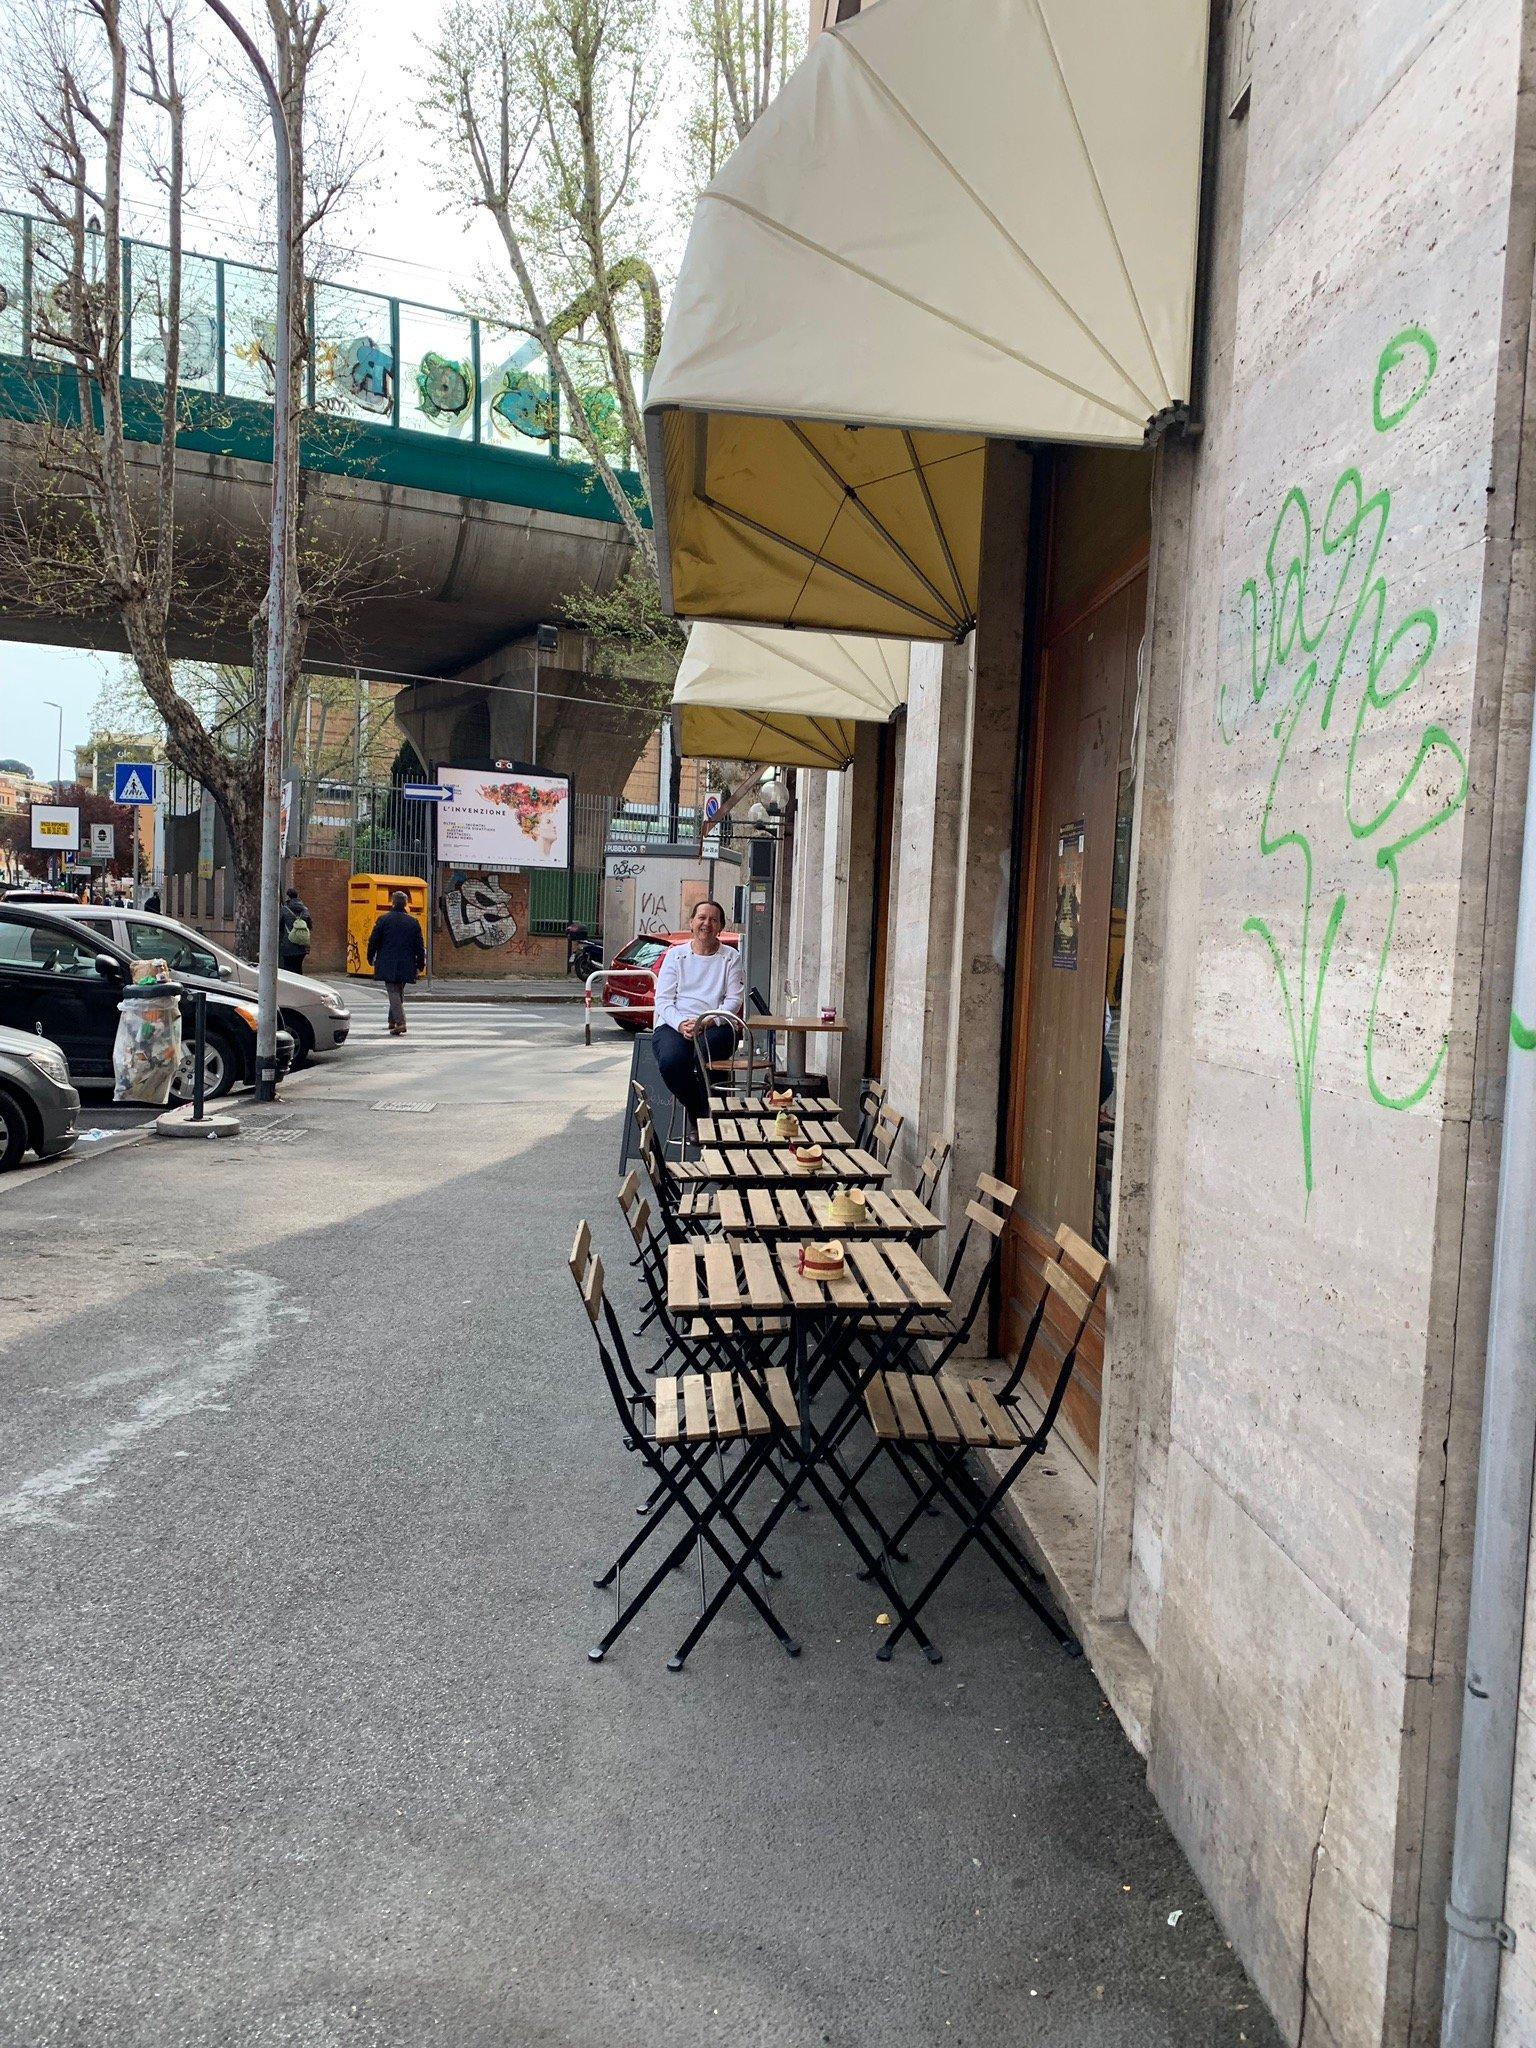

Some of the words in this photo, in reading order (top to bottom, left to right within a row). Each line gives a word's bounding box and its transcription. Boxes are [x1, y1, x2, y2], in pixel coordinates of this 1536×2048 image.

[443, 806, 506, 817] L'INVENZIONE
[607, 845, 638, 853] PUBBLICO
[641, 892, 667, 915] VIA
